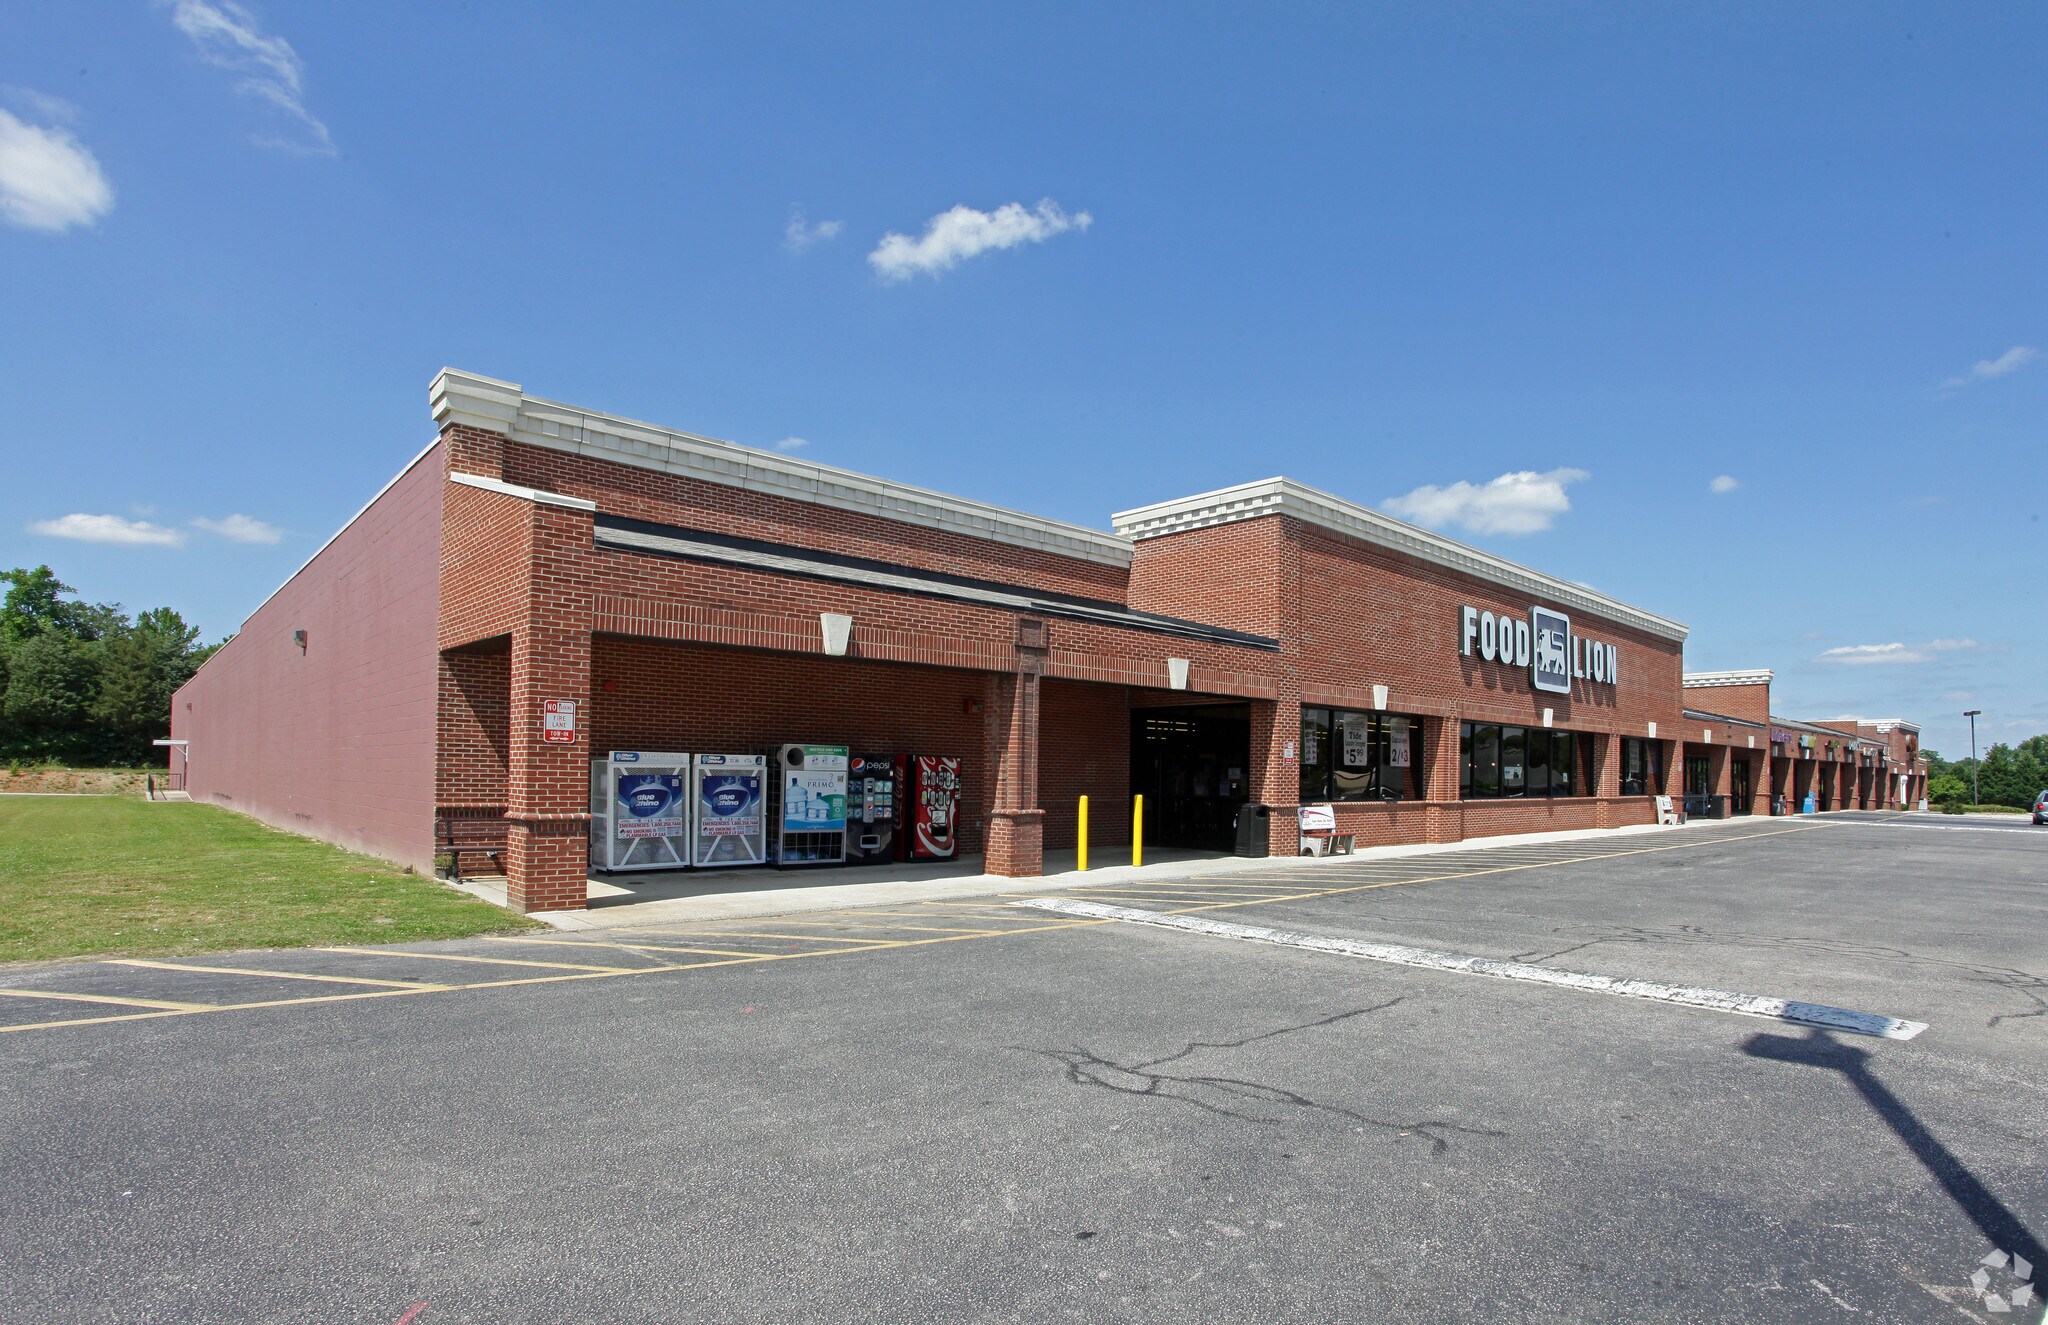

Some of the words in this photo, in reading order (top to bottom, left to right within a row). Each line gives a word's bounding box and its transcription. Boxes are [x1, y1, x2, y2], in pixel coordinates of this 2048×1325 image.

[1459, 605, 1530, 667] FOOD
[1571, 635, 1617, 685] LION
[547, 703, 557, 711] NO
[1348, 731, 1362, 740] Tide
[866, 761, 890, 770] pepsi
